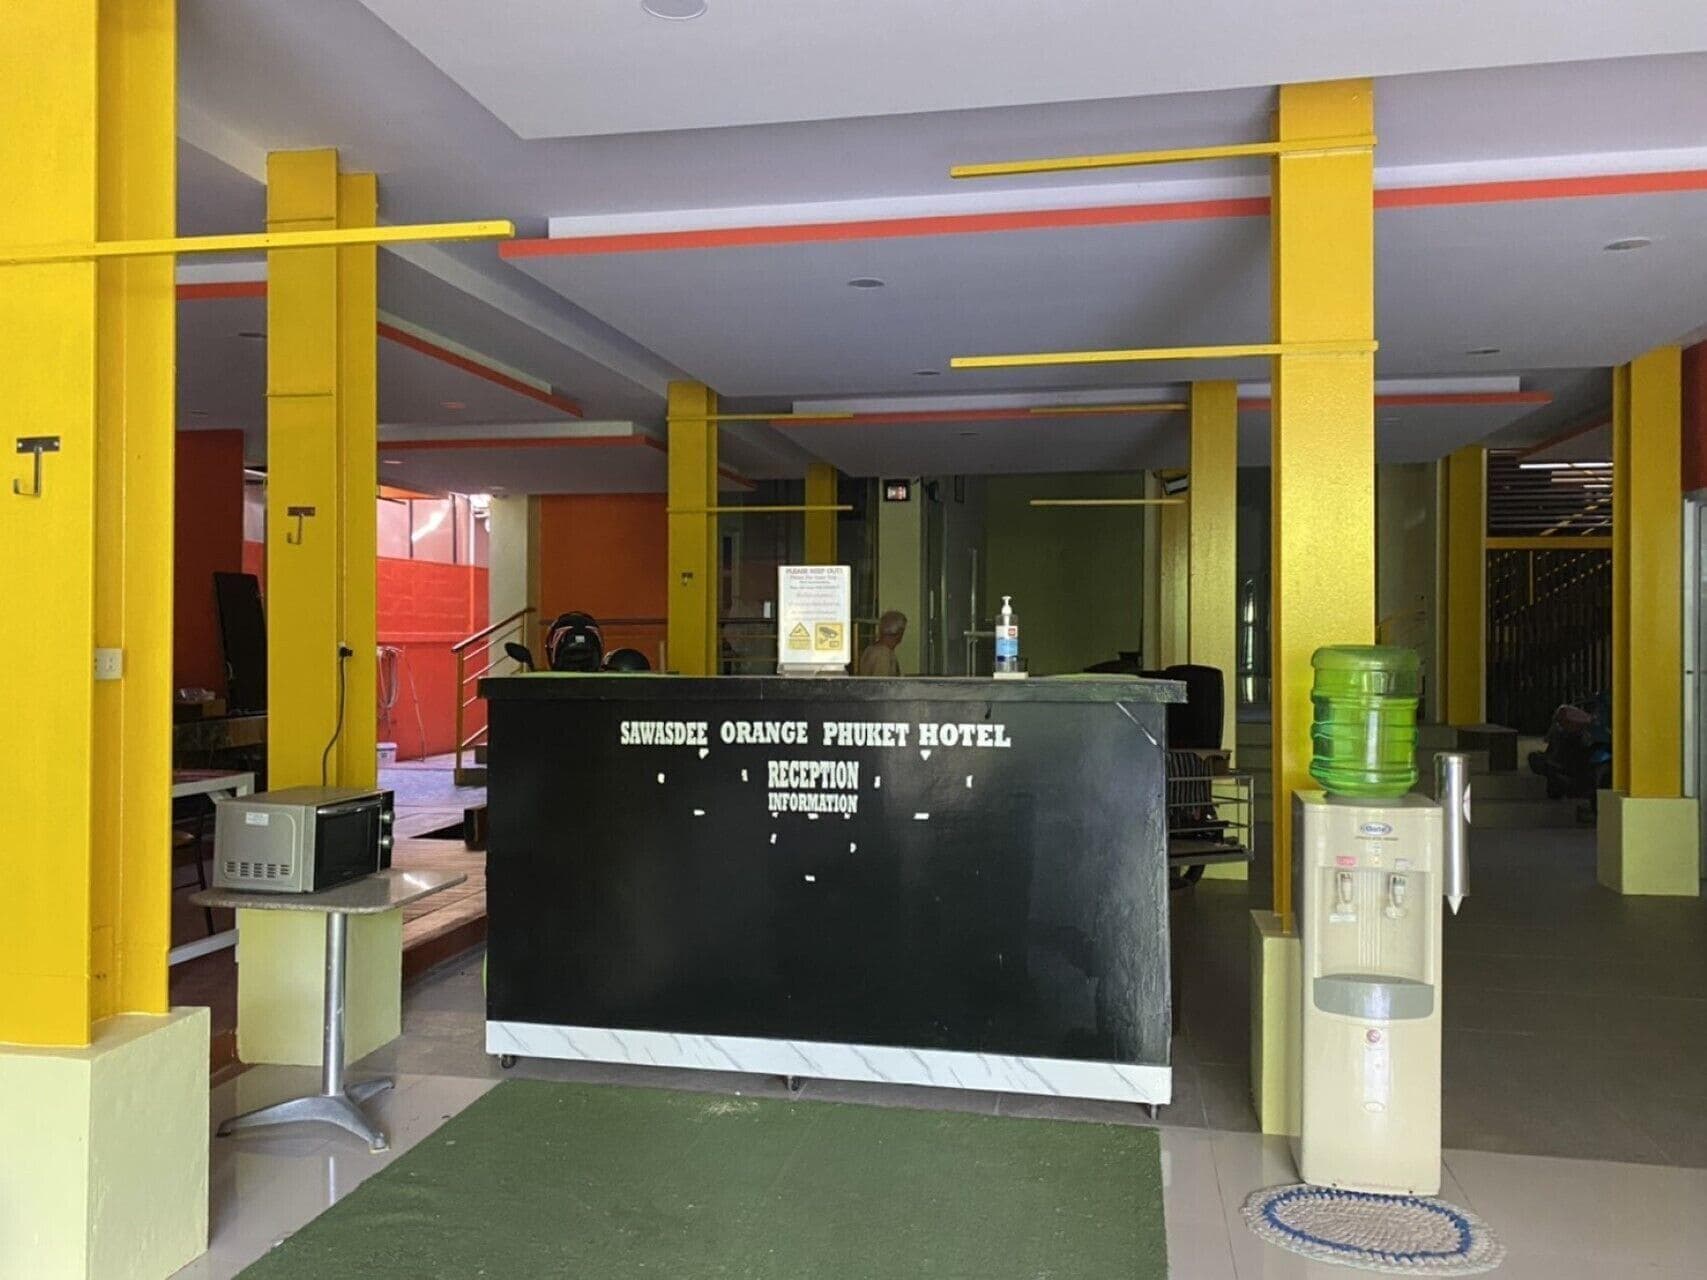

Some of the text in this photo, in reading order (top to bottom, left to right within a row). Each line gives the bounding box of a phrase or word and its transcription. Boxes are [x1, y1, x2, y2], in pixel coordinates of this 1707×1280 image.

[620, 720, 1012, 748] SAWASDEE ORANGE PHUKET HOTEL
[767, 760, 860, 789] RECEPTION
[767, 792, 859, 814] INFORMATION
